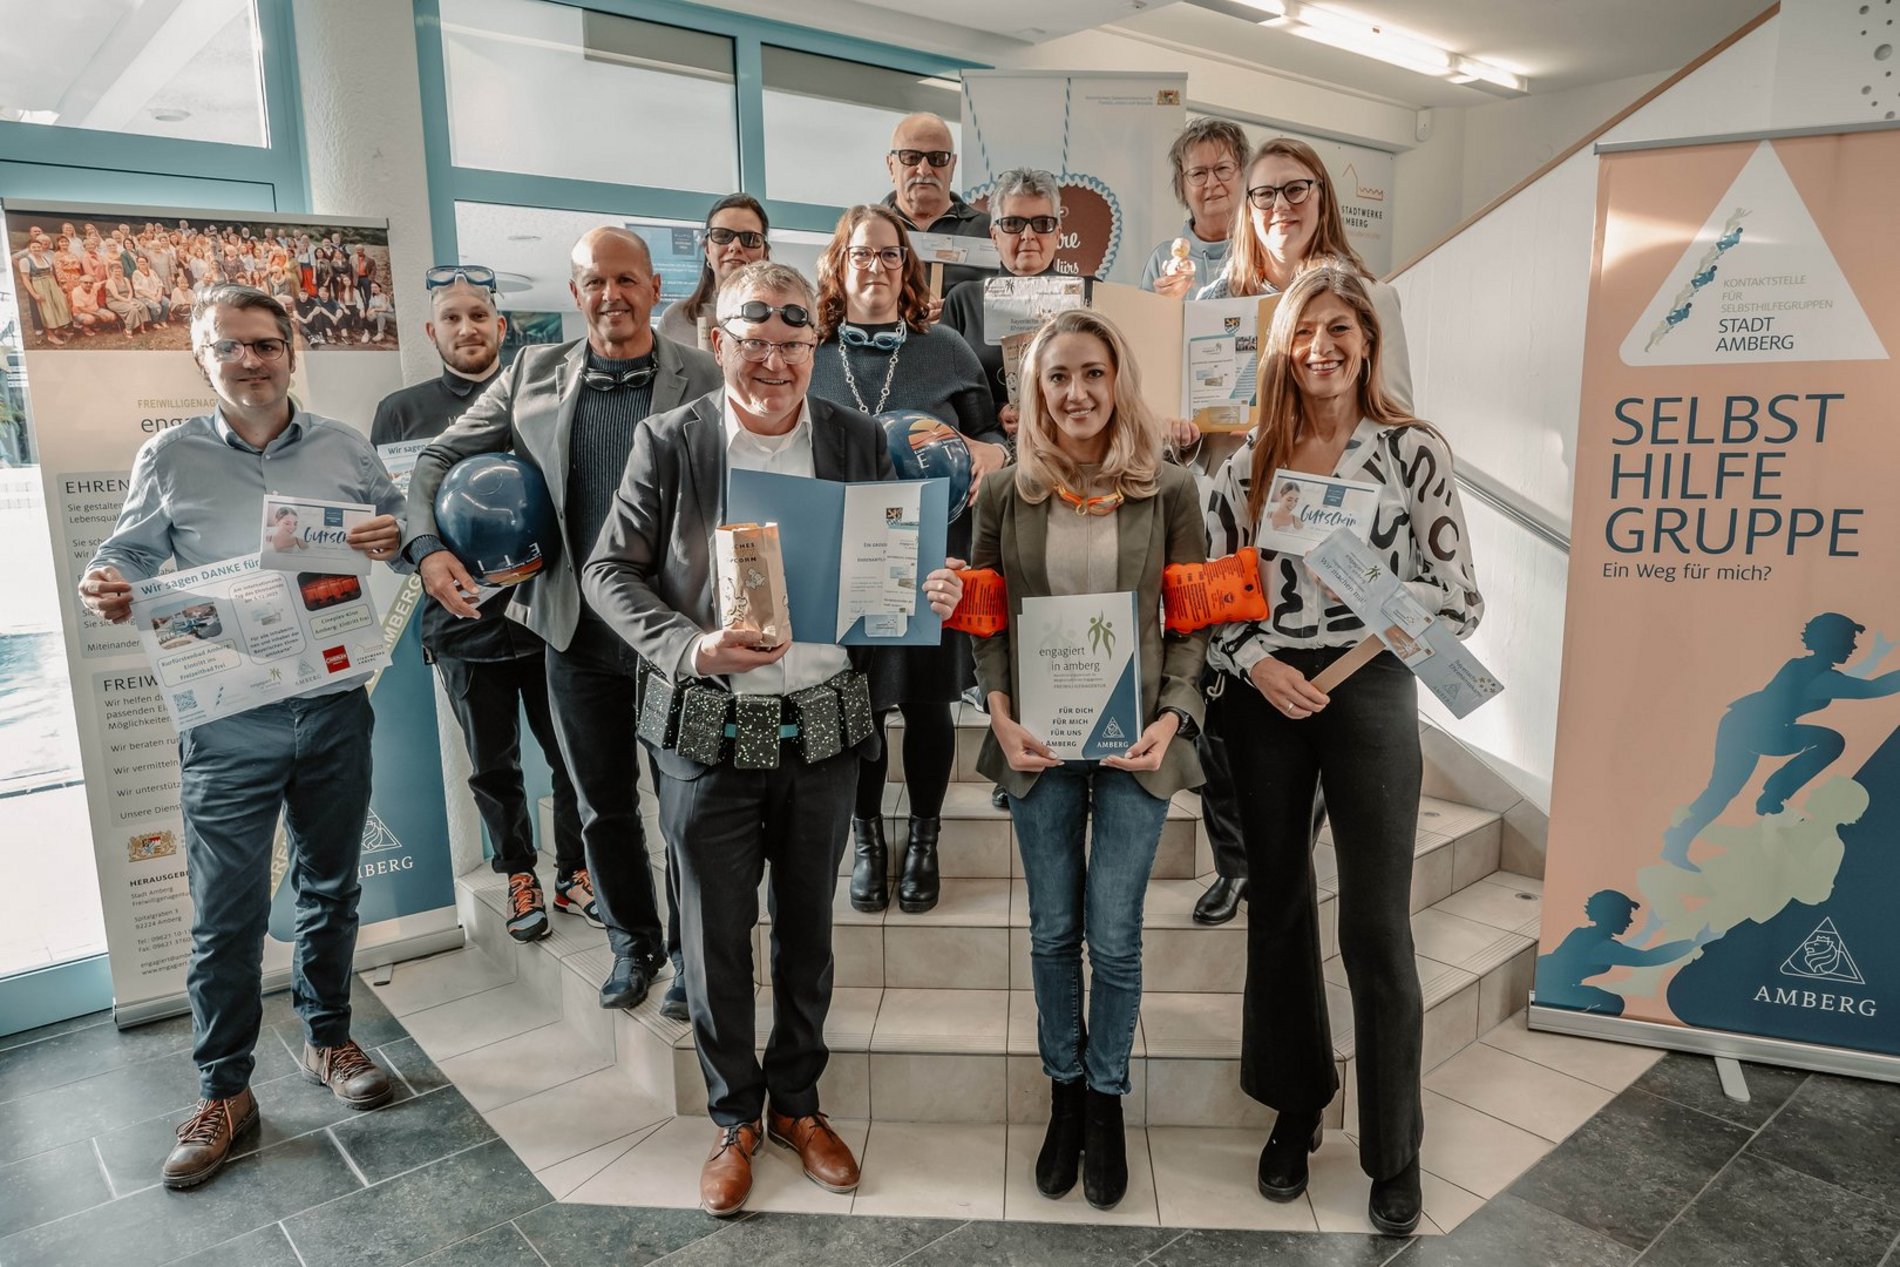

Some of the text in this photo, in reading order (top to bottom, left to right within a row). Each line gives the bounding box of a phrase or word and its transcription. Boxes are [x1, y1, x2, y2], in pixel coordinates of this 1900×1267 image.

[1341, 205, 1383, 220] STADTWERKE
[1723, 275, 1806, 288] KONTAKTSTELLE
[1722, 289, 1743, 301] FÜR
[1720, 300, 1833, 313] SELBSTHILFEGRUPPEN
[1718, 317, 1775, 334] STADT
[1716, 334, 1794, 352] AMBERG
[1611, 393, 1845, 446] SELBST
[1610, 451, 1787, 500] HILFE
[68, 504, 80, 512] Sie
[1604, 507, 1864, 558] GRUPPE
[141, 560, 260, 595] Wir sagen DANKE für
[1602, 562, 1772, 583] Ein Weg für mich?
[88, 640, 140, 652] Miteinander
[1039, 646, 1085, 658] engagiert
[1051, 661, 1100, 672] in amberg
[104, 674, 158, 692] FREIW
[105, 700, 120, 708] Wir
[123, 695, 152, 706] helfen
[106, 704, 156, 720] passenden
[1058, 706, 1073, 714] FÜR
[111, 744, 126, 752] Wir
[130, 739, 164, 750] beraten
[114, 760, 178, 776] Wir vermitteln
[116, 790, 132, 798] Wir
[120, 808, 152, 820] Unsere
[1753, 985, 1877, 1017] AMBERG
